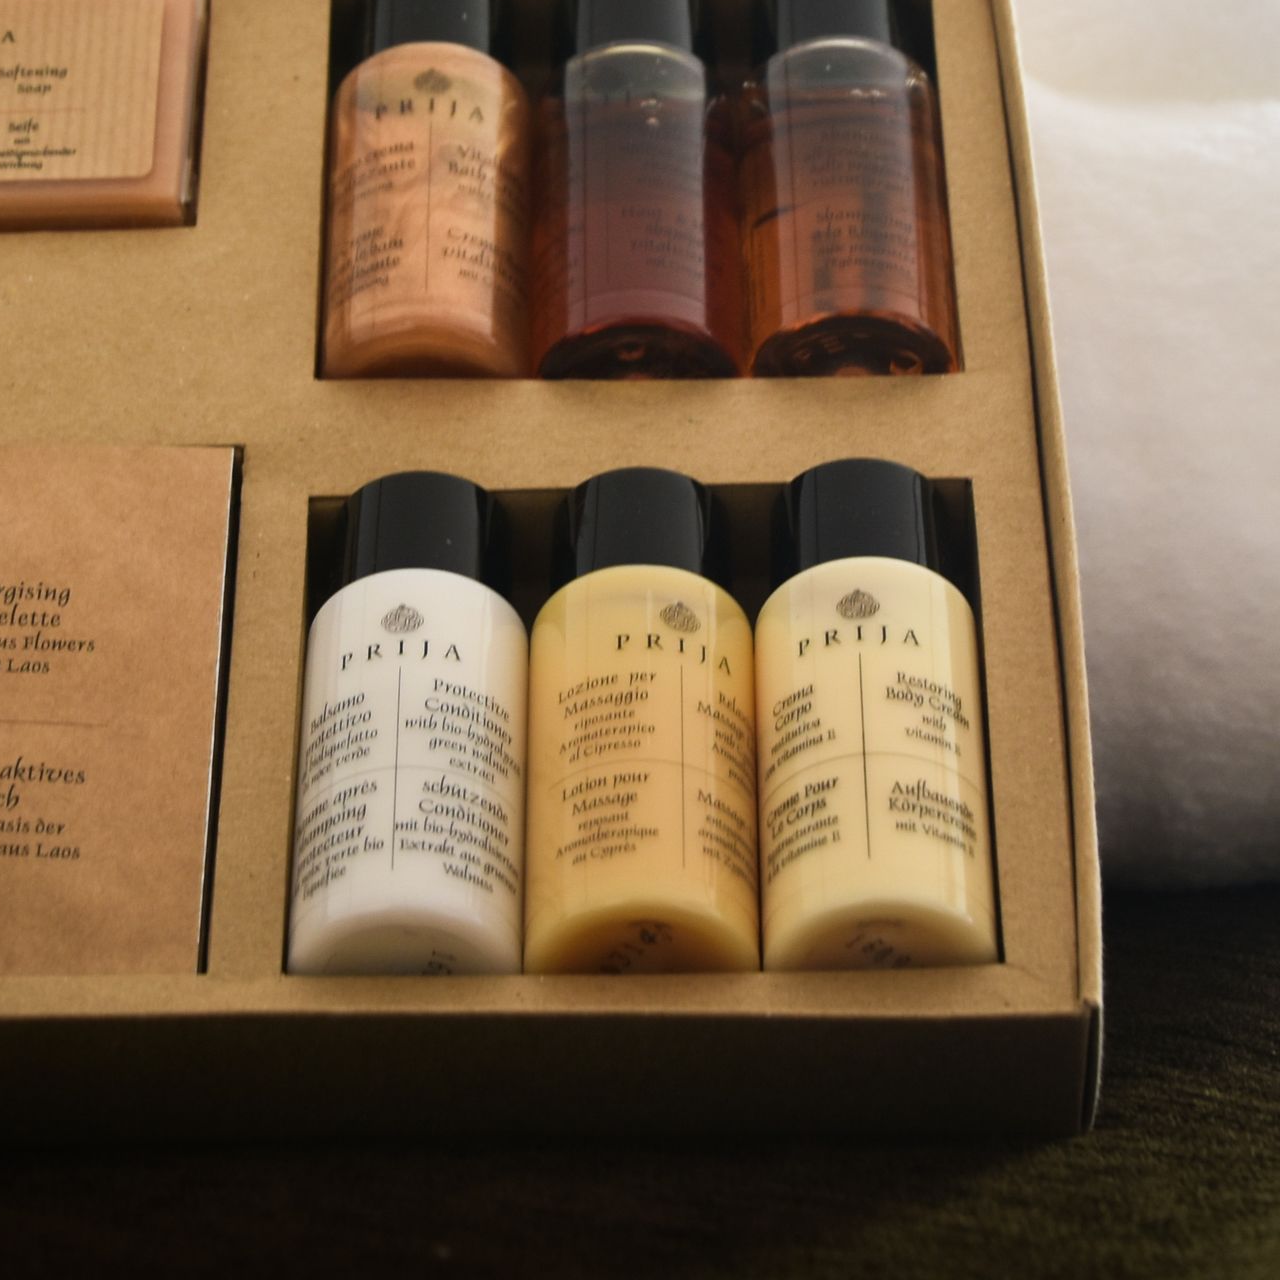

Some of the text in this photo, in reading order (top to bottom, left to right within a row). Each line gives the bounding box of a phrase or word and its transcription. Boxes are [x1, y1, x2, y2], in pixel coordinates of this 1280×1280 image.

[22, 630, 96, 653] Flowers
[340, 639, 462, 671] PRIJA
[616, 633, 732, 677] PRIJA
[798, 624, 919, 657] PRIJA
[6, 657, 51, 674] Laos
[433, 677, 510, 724] Protective
[558, 671, 657, 705] Lozione per
[564, 685, 650, 719] Massaggio
[772, 683, 814, 718] Crema
[896, 670, 963, 714] Restoring
[404, 713, 438, 731] with
[424, 697, 513, 746] Conditioner
[574, 709, 636, 731] riposante
[774, 701, 812, 733] Corpo
[885, 685, 970, 731] Body Cream
[429, 736, 467, 756] green
[583, 739, 641, 757] Cipresso
[562, 771, 651, 802] Lotion pour
[804, 776, 839, 798] Pour
[572, 791, 639, 817] Massage
[786, 796, 827, 825] Corps
[35, 816, 66, 836] der
[394, 817, 420, 832] mit
[418, 798, 510, 847] Conditioner
[35, 841, 81, 860] Laos
[363, 834, 385, 853] bio
[399, 837, 456, 857] Extrakt
